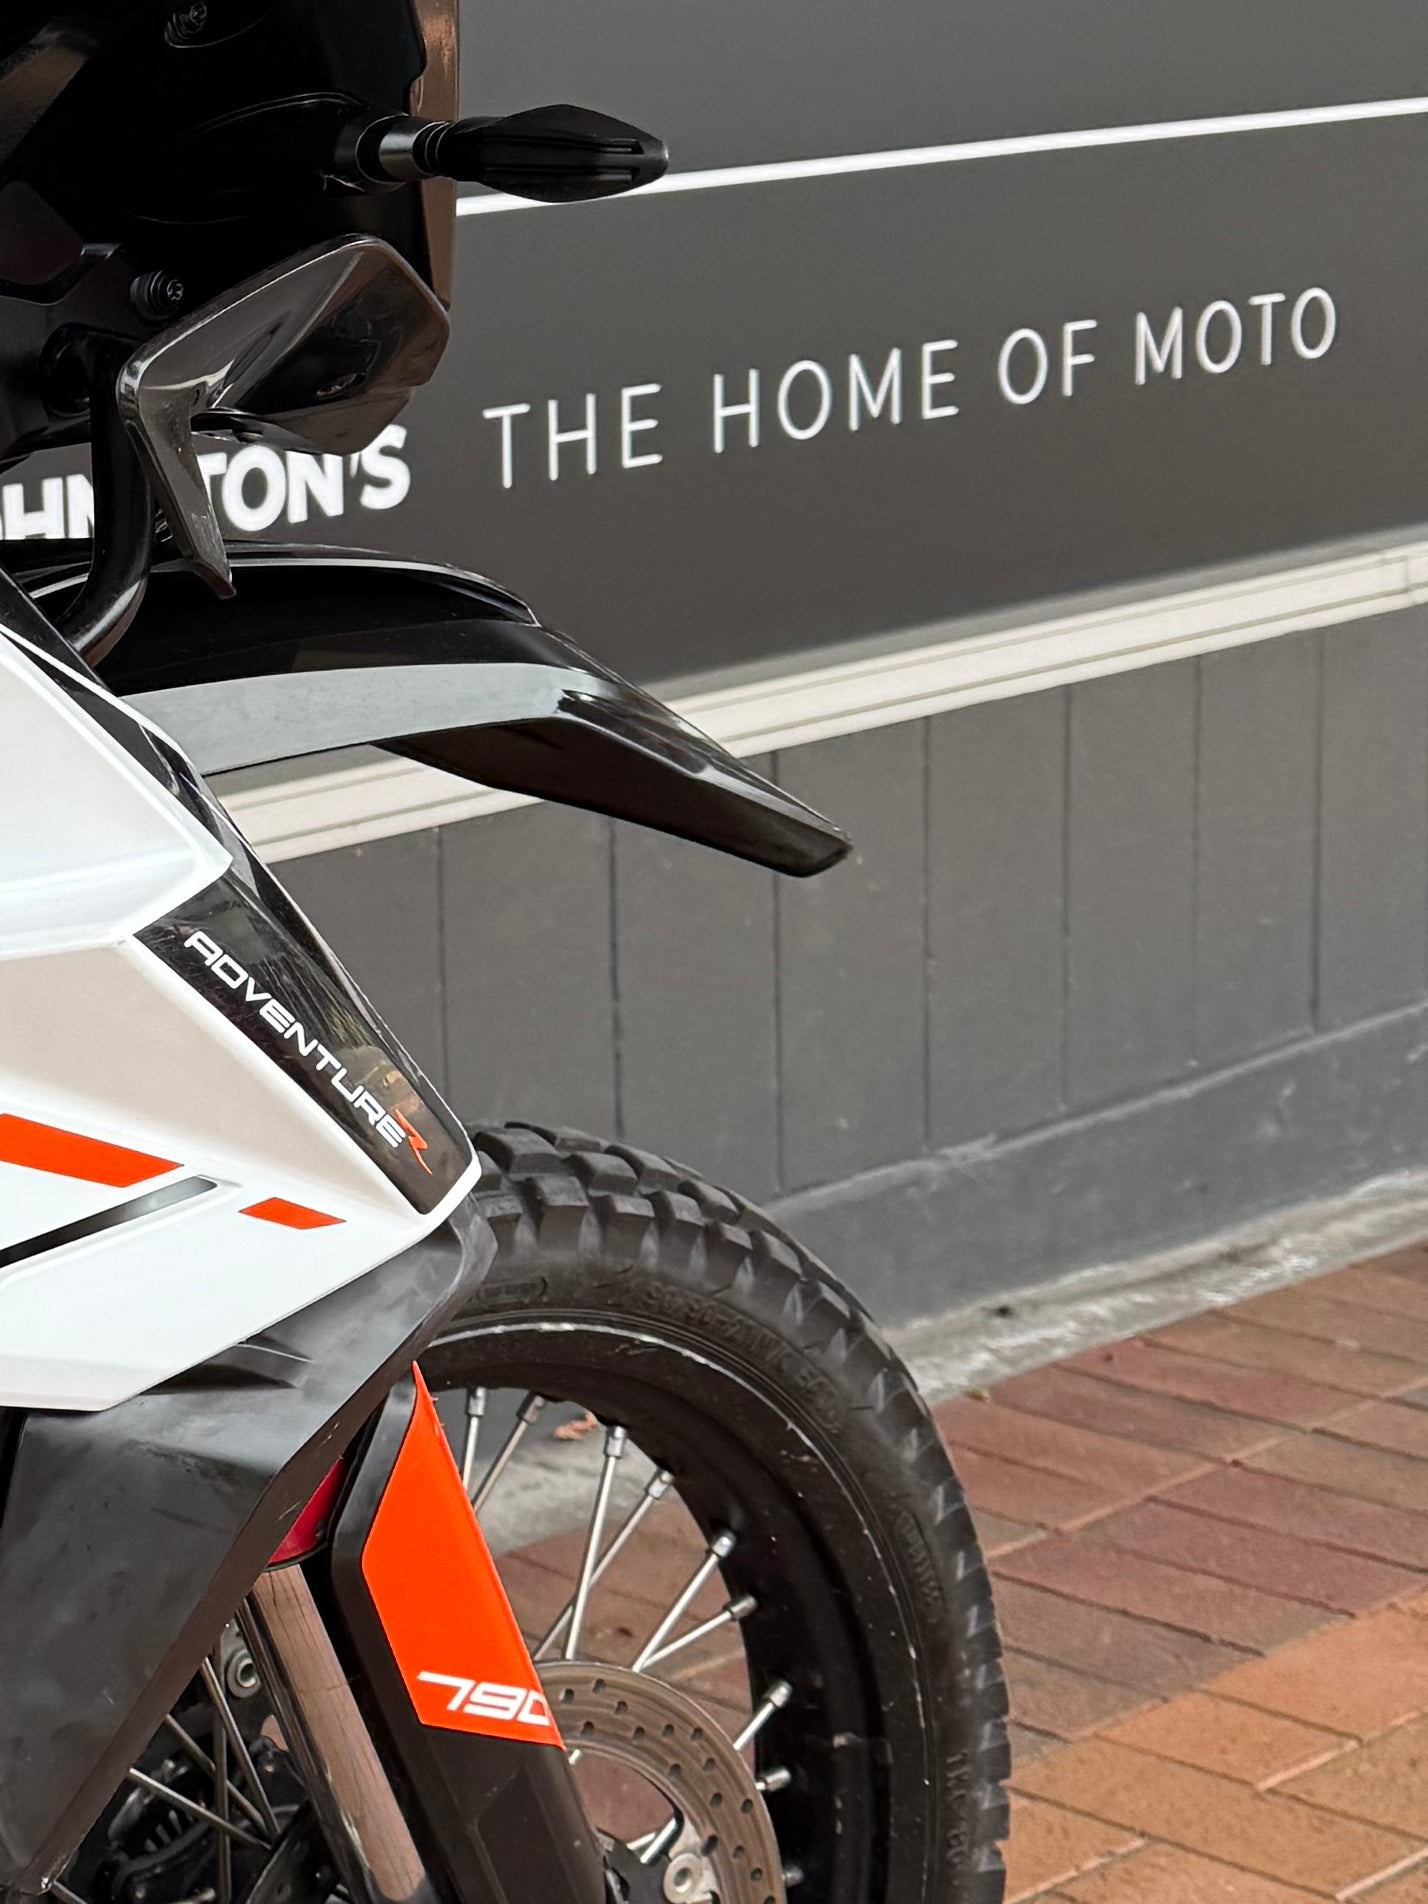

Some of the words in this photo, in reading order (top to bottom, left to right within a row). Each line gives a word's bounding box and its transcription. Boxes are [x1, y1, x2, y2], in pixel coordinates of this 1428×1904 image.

[482, 383, 663, 489] THE
[713, 339, 959, 454] HOME
[998, 319, 1098, 405] OF
[1135, 287, 1336, 385] MOTO
[184, 930, 407, 1148] ADVENTURE
[416, 1670, 550, 1726] 790
